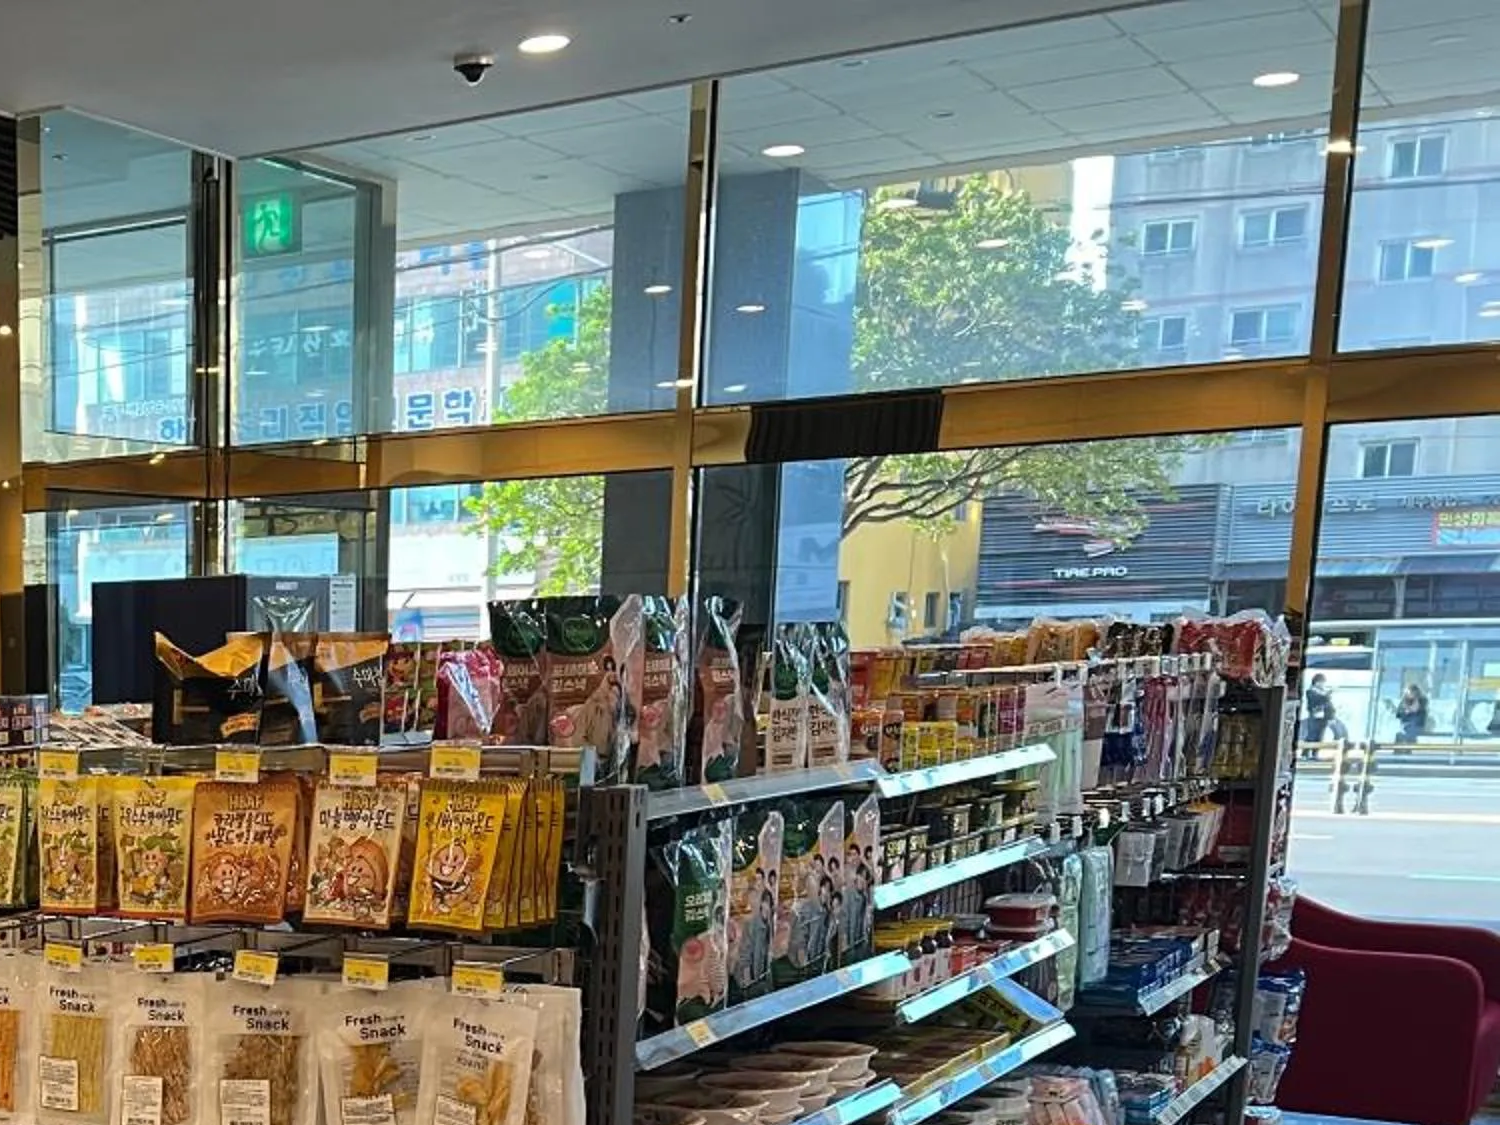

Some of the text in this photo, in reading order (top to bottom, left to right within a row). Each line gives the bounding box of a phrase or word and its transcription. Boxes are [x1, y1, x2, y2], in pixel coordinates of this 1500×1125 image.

[50, 985, 79, 999] Fresh
[58, 998, 96, 1013] Snack
[137, 996, 167, 1009] Fresh
[147, 1009, 186, 1023] Snack
[232, 1004, 267, 1017] Fresh
[246, 1017, 290, 1031] Snack
[344, 1013, 382, 1027] Fresh
[359, 1023, 408, 1040] Snack
